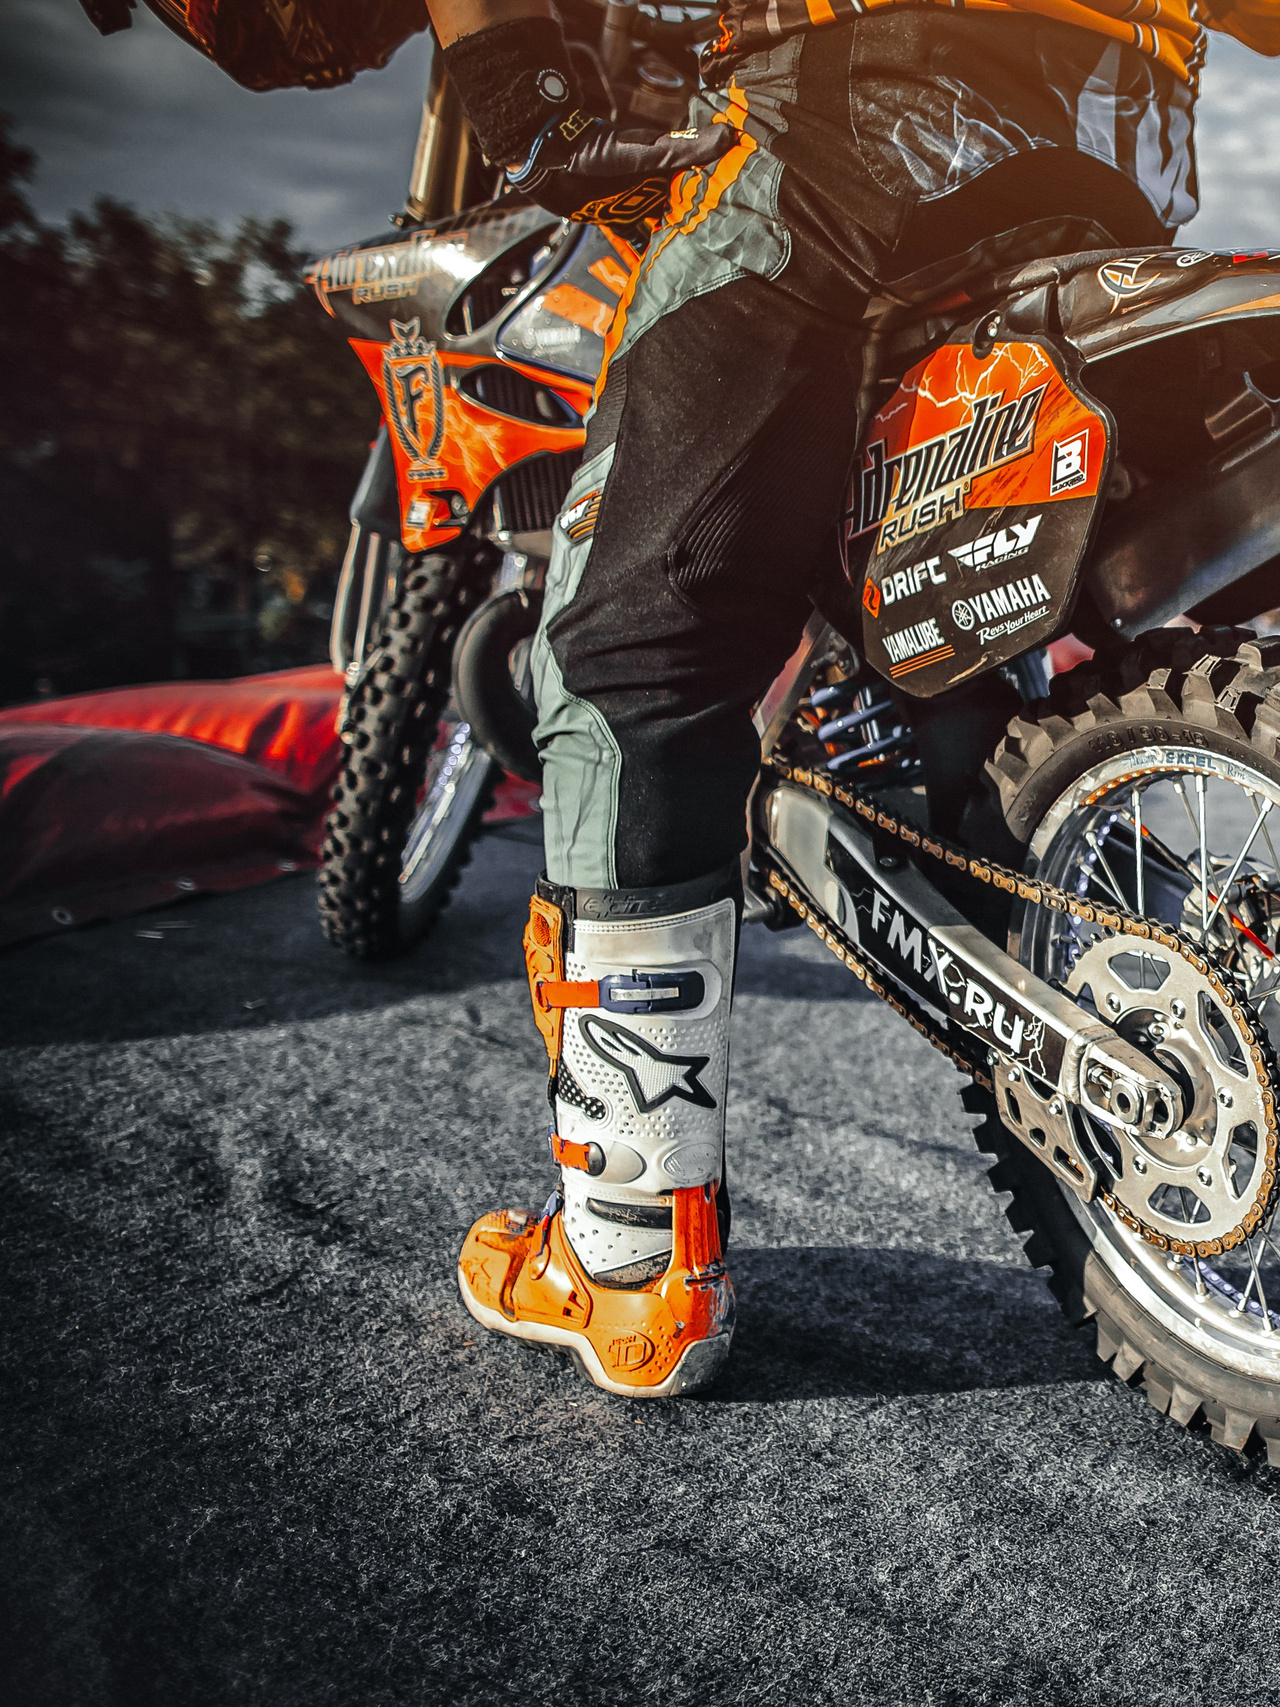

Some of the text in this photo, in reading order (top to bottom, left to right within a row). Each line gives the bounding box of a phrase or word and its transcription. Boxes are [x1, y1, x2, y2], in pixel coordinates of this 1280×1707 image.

[948, 514, 1042, 568] FLY
[975, 547, 1029, 571] RACING
[881, 556, 947, 606] DRIFT
[968, 573, 1051, 623] YAMAHA
[882, 617, 945, 664] YAMALUBE
[1165, 752, 1216, 770] EXCEL
[870, 886, 1026, 1053] FMX.RU
